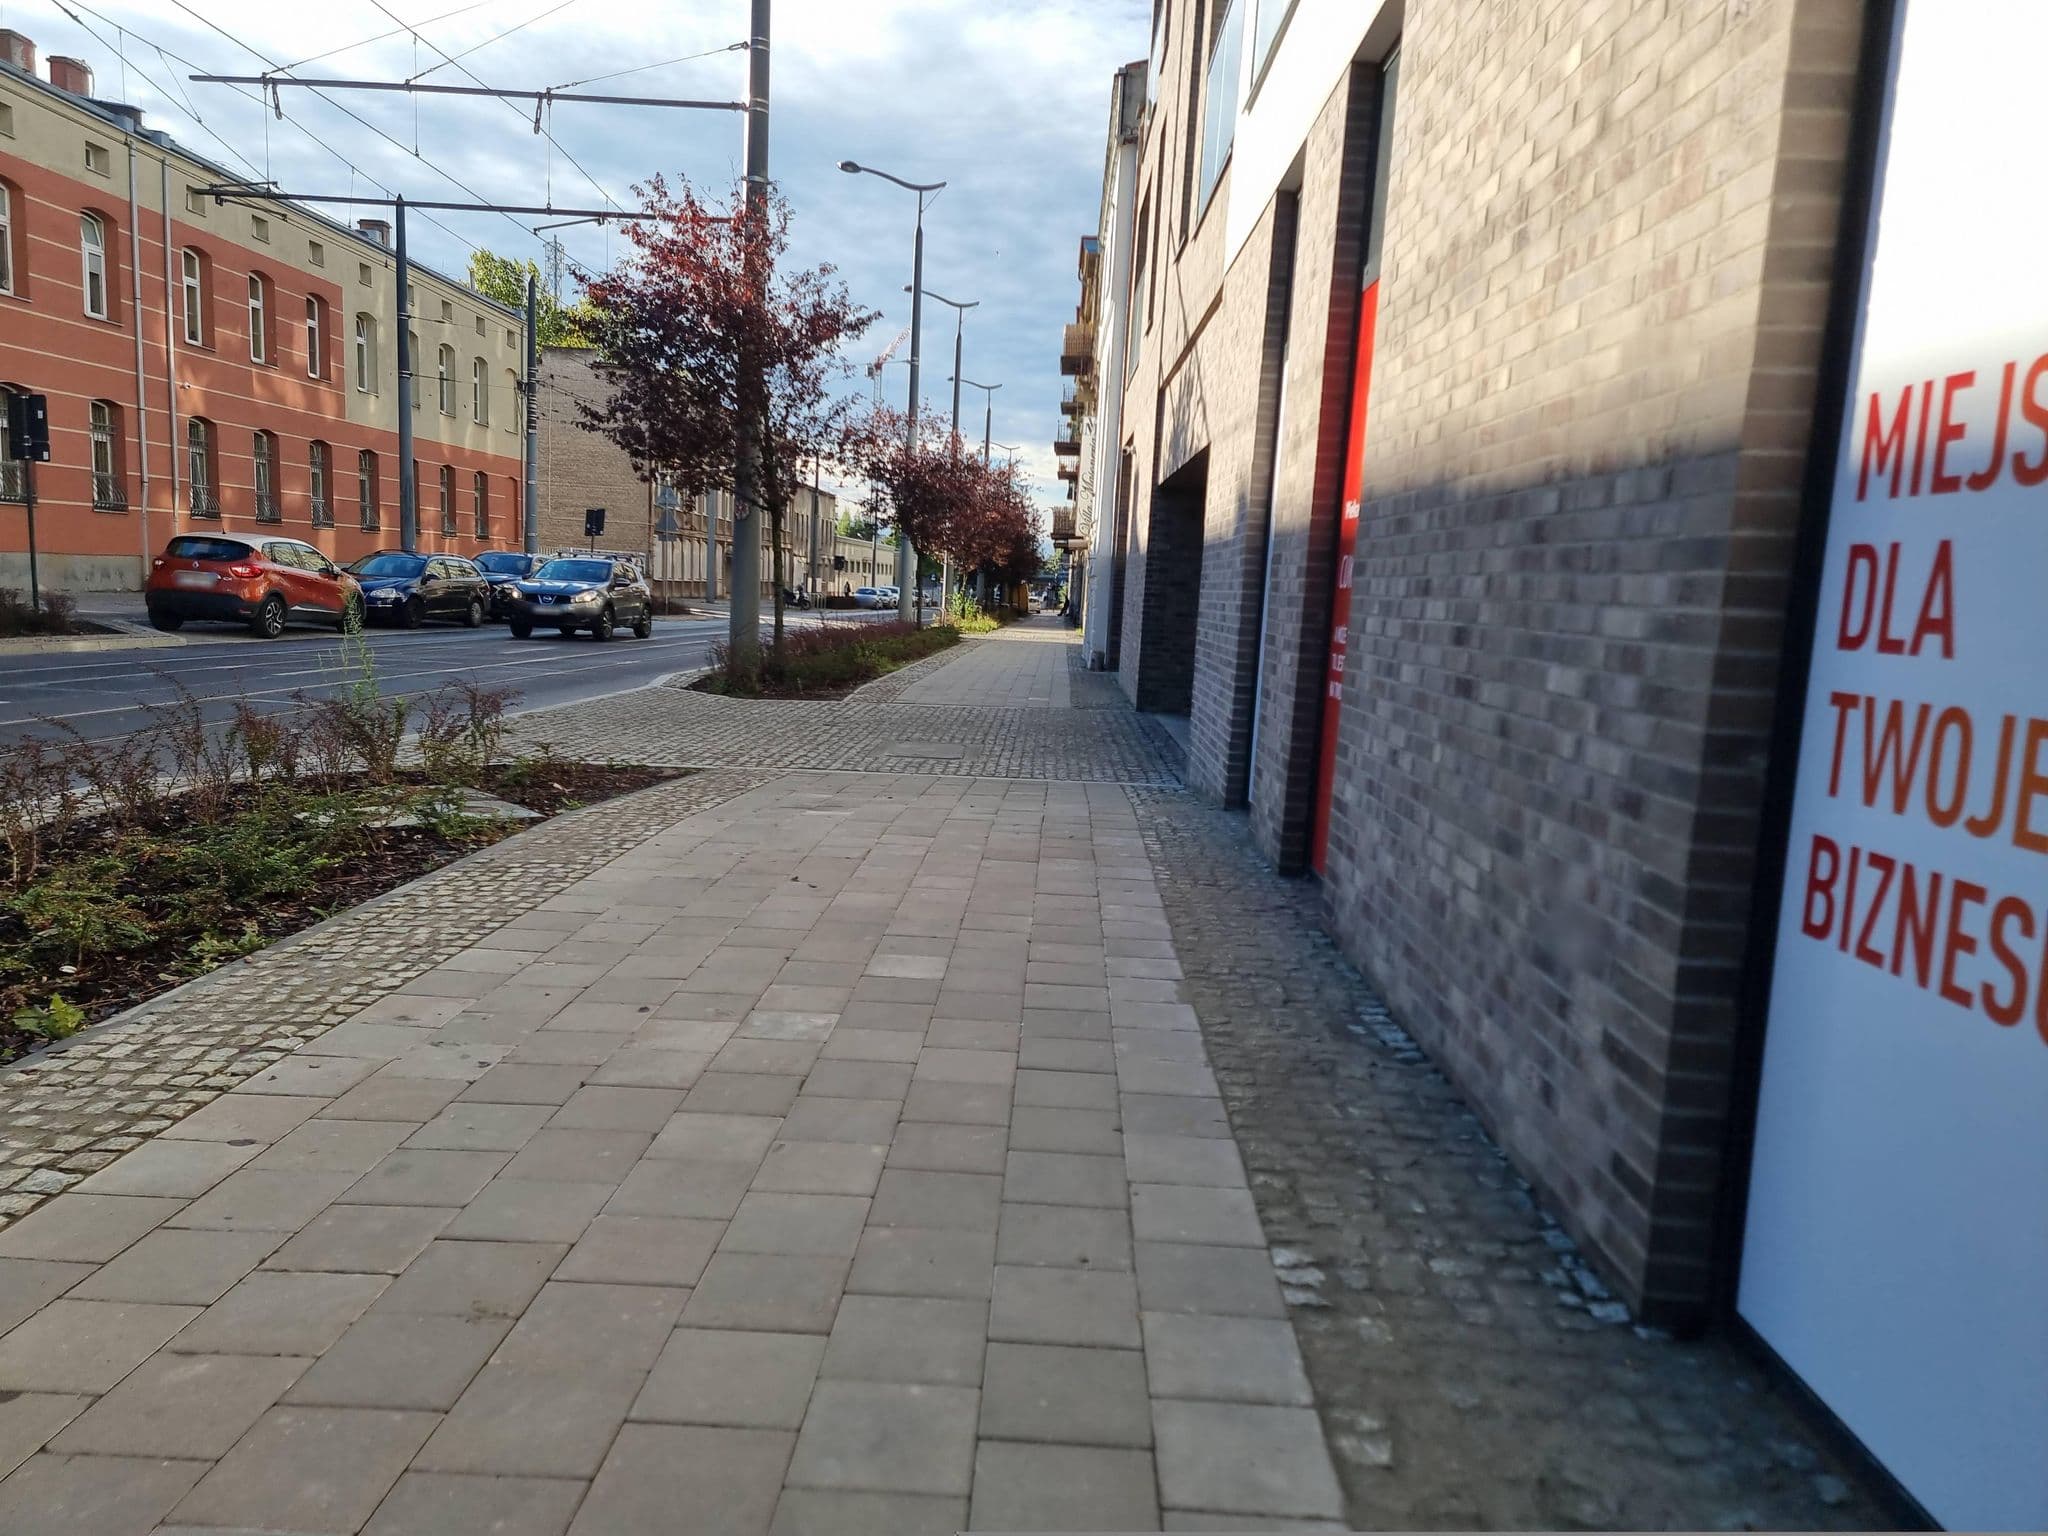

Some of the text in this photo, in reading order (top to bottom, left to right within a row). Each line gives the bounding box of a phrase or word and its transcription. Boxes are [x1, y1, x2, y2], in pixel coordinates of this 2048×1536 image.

[1857, 352, 2048, 502] MIEJS
[1837, 539, 1954, 660] DLA
[1827, 690, 2048, 856] TWOJE
[1801, 833, 2048, 1049] BIZNES
